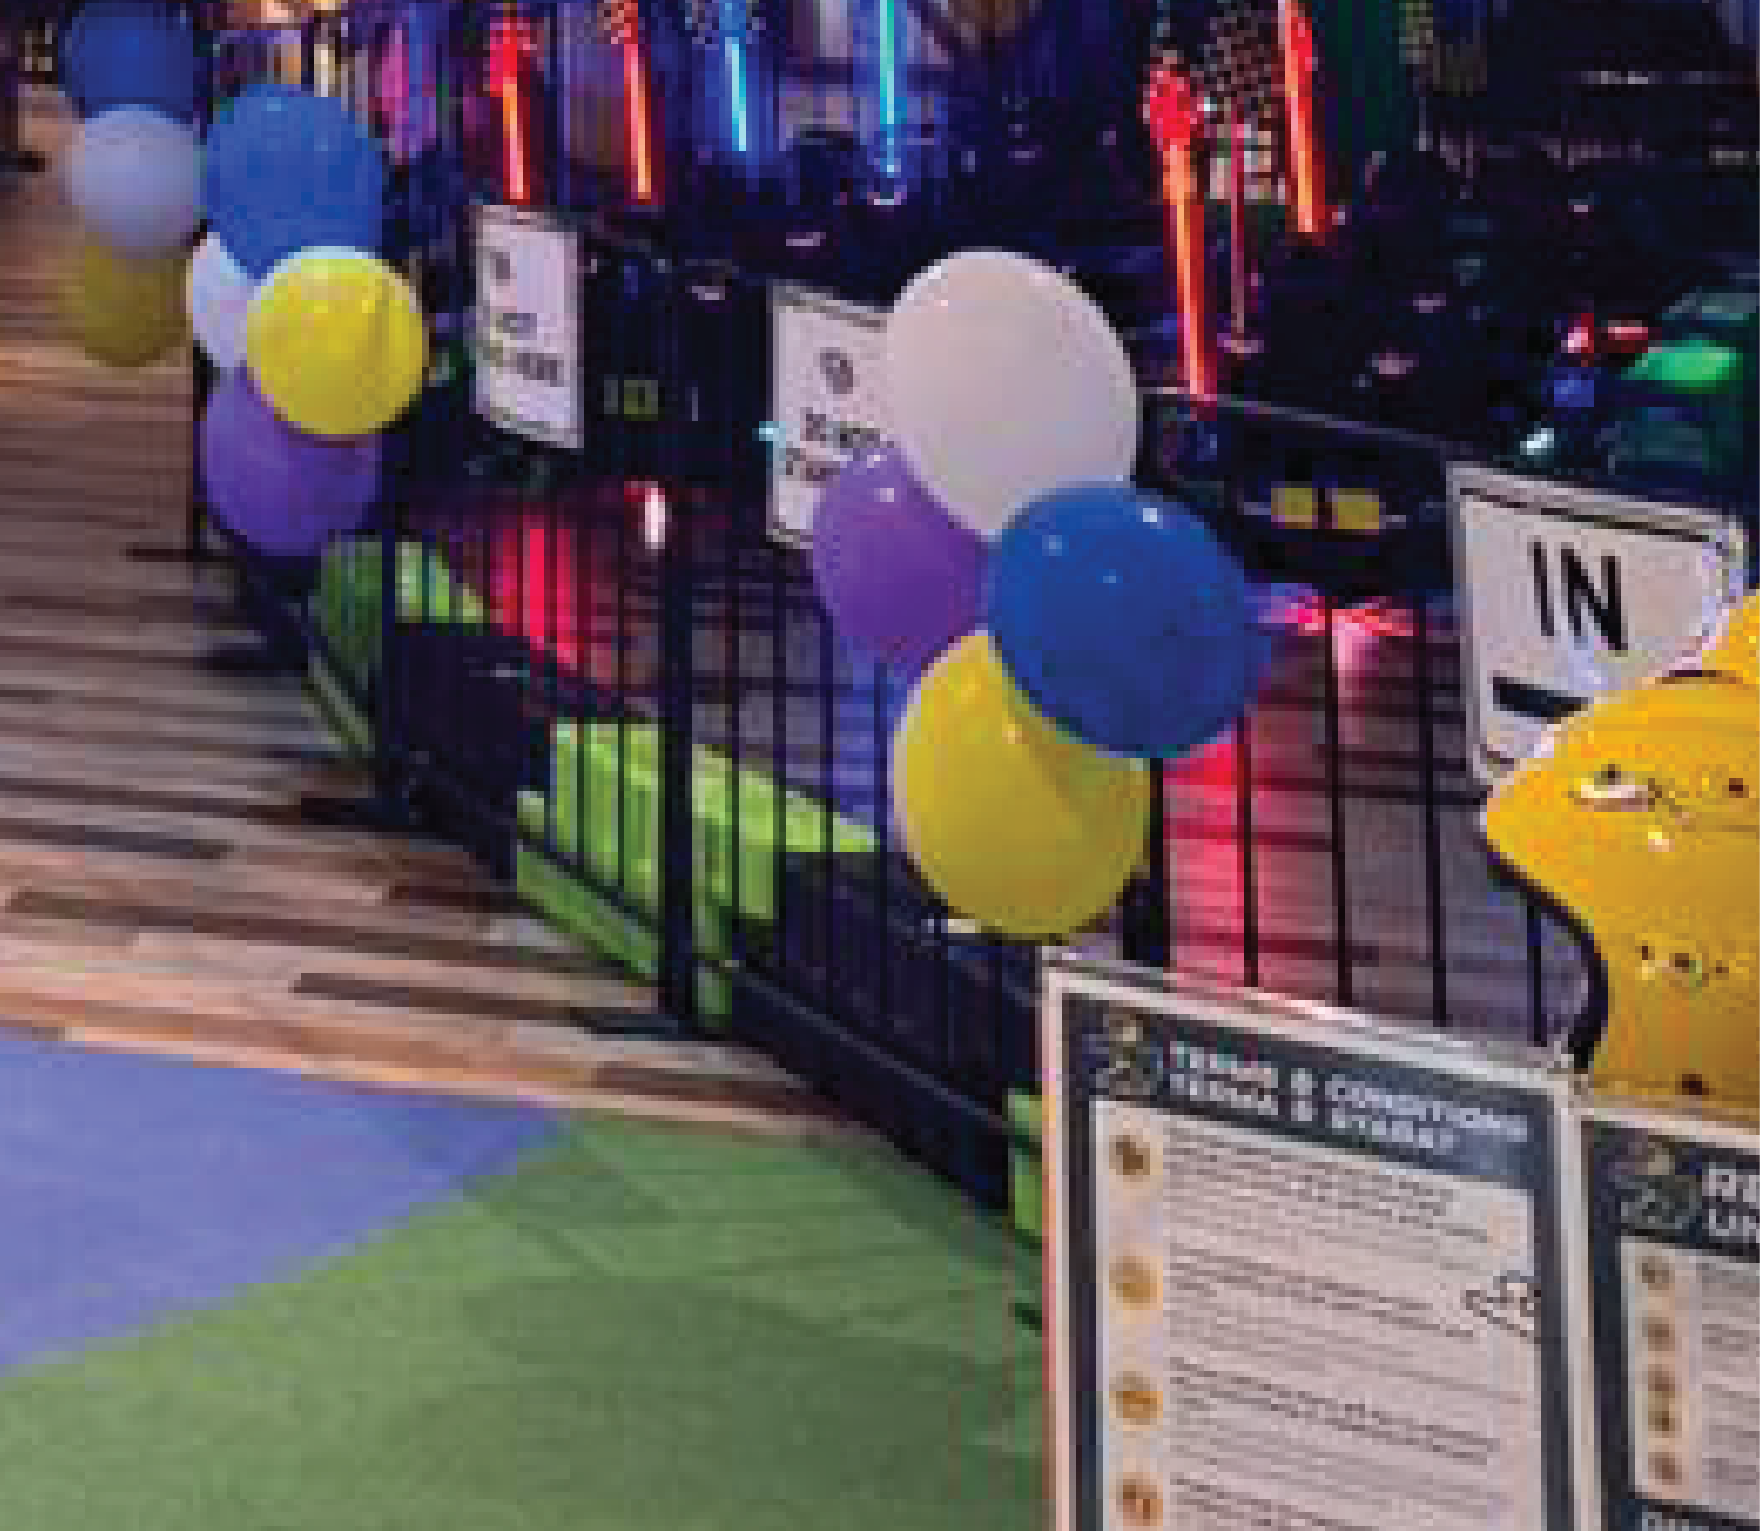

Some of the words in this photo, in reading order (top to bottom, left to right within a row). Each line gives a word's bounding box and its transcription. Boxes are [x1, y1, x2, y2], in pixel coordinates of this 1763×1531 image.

[1530, 539, 1628, 654] IN
[1169, 1039, 1276, 1086] TERMS
[1323, 1072, 1530, 1144] CONDITIONS
